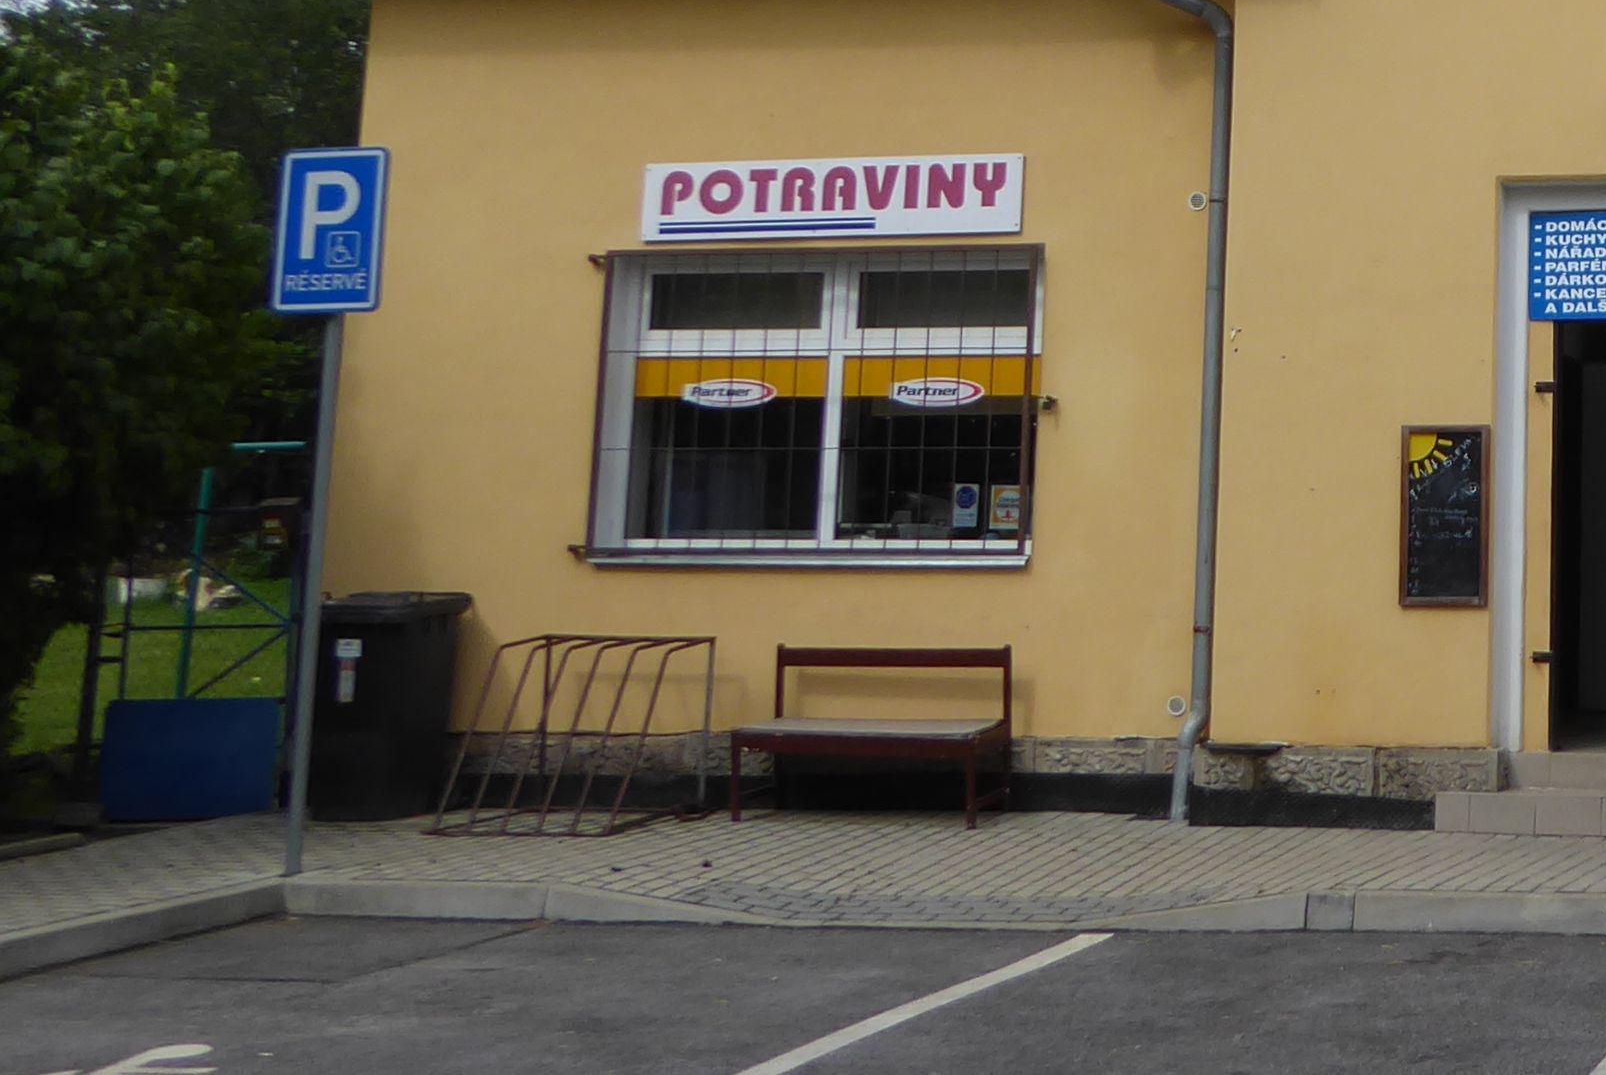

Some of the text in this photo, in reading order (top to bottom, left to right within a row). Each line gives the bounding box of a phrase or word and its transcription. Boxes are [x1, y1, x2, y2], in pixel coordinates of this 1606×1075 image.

[659, 162, 1007, 216] POTRAVINY
[299, 170, 361, 259] P
[1544, 303, 1557, 314] A
[896, 384, 959, 397] Partner
